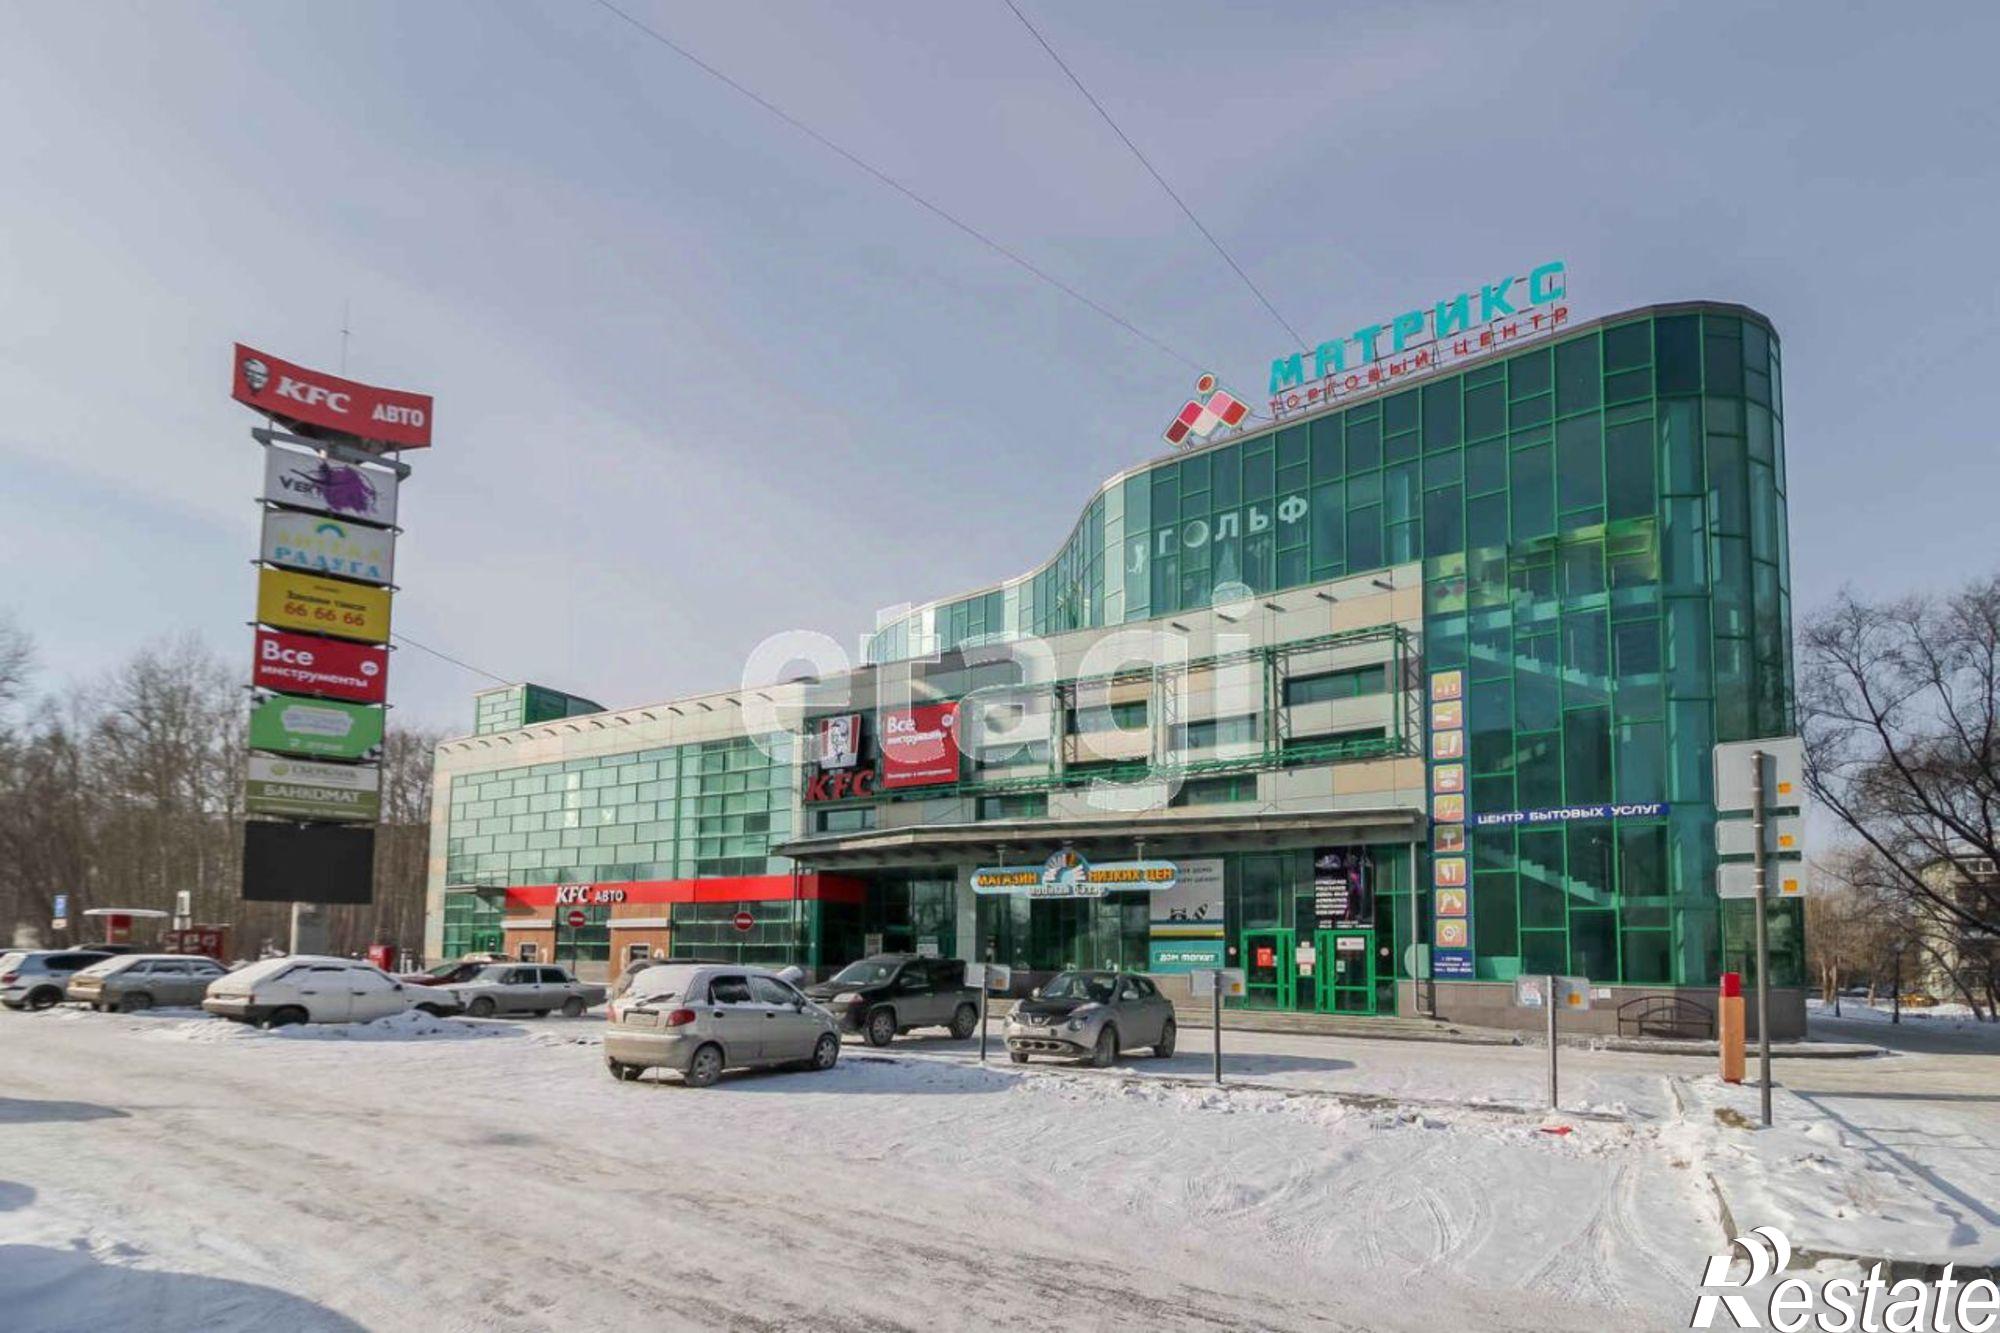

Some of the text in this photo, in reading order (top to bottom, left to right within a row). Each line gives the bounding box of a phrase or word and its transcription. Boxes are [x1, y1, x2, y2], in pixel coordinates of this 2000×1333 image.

[1269, 261, 1566, 396] МАТРИКС
[1269, 306, 1569, 412] ТОРГОВЫЙ ЦЕНТР
[275, 375, 425, 428] KFC АВТО
[1158, 495, 1308, 555] ГОЛЬФ
[274, 546, 382, 578] РАДУГА
[284, 601, 365, 627] 66 66 66
[261, 639, 315, 667] Все
[261, 664, 368, 688] инструменты
[887, 716, 916, 733] Все
[263, 783, 362, 803] БАНКОМАТ
[805, 769, 875, 801] KFC
[1478, 803, 1662, 825] ЦЕНТР БЫТОВЫХ УСЛУГ
[976, 871, 1038, 888] МАГАЗИН
[1087, 867, 1142, 883] НИЗКИХ
[1143, 867, 1174, 883] ЦЕН
[555, 885, 625, 904] KFC АВТО
